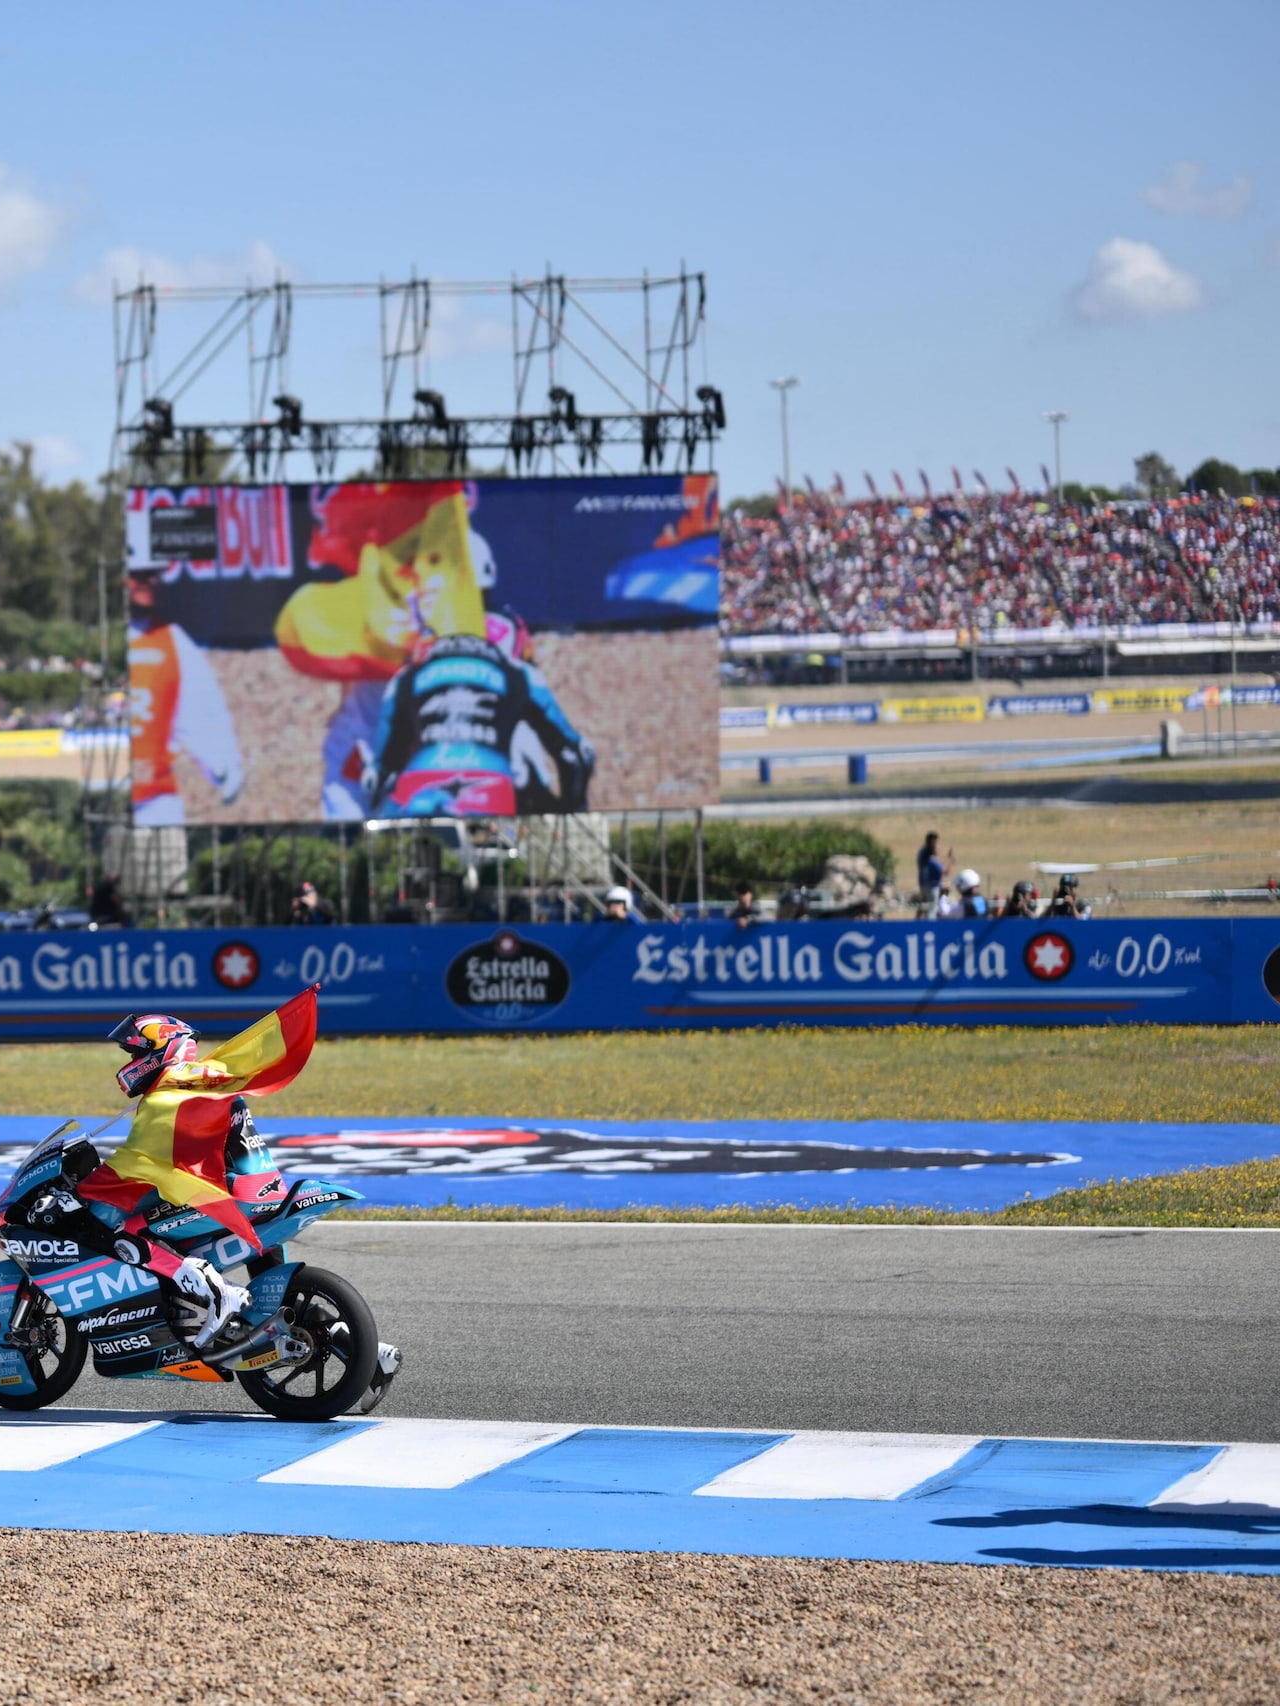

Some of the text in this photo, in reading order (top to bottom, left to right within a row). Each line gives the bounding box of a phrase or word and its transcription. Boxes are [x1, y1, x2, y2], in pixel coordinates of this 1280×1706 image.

[32, 941, 198, 991] Galicia
[632, 930, 1008, 983] Estrella Galicia
[1115, 933, 1172, 978] 0,0
[466, 956, 550, 979] Estrella
[469, 979, 546, 1002] Galicia
[128, 1057, 161, 1081] Red Bull
[17, 1160, 58, 1187] CFMOTO
[296, 1192, 339, 1209] valresa
[107, 1305, 158, 1325] CIRCUIT
[93, 1334, 152, 1355] valresa
[248, 1351, 278, 1368] PIRELLI
